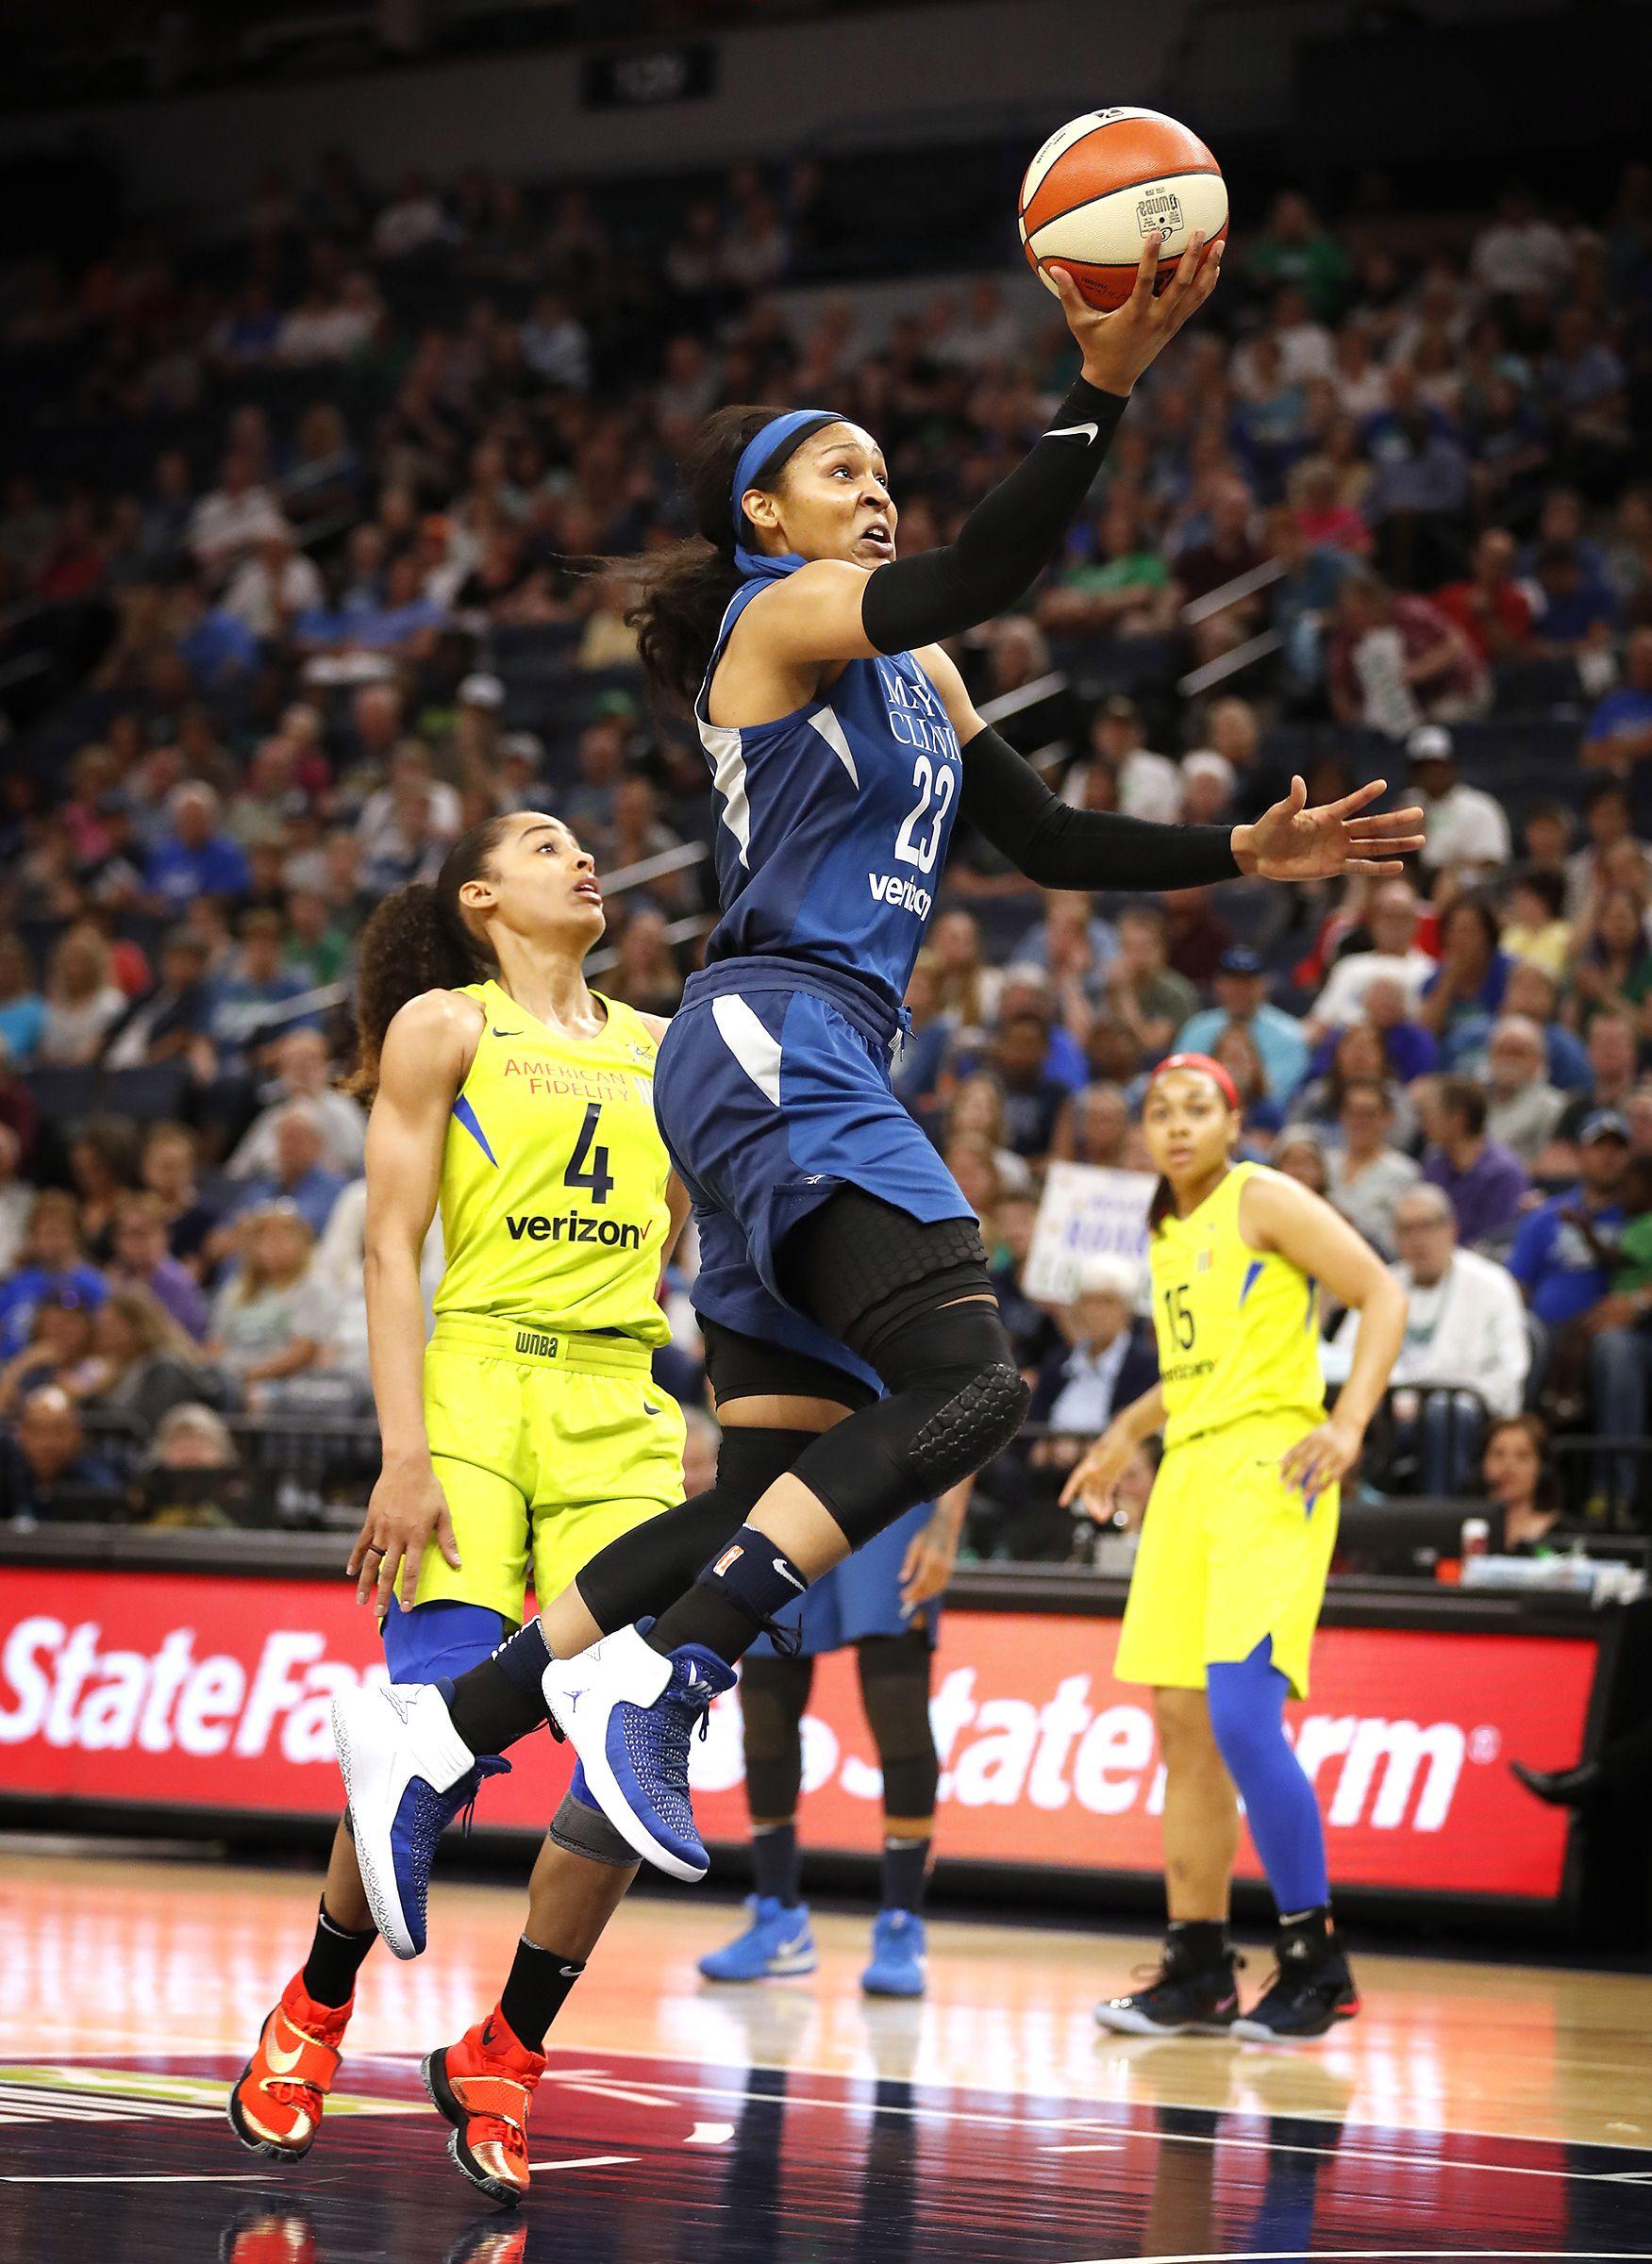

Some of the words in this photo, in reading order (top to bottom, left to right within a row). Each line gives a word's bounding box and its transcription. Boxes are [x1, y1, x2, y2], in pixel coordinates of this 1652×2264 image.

[895, 755, 955, 874] 23
[505, 1058, 626, 1085] AMERICAN
[529, 1077, 628, 1102] FIDELITY
[563, 1103, 614, 1205] 4
[506, 1210, 640, 1249] verizon
[1165, 1284, 1195, 1352] 15
